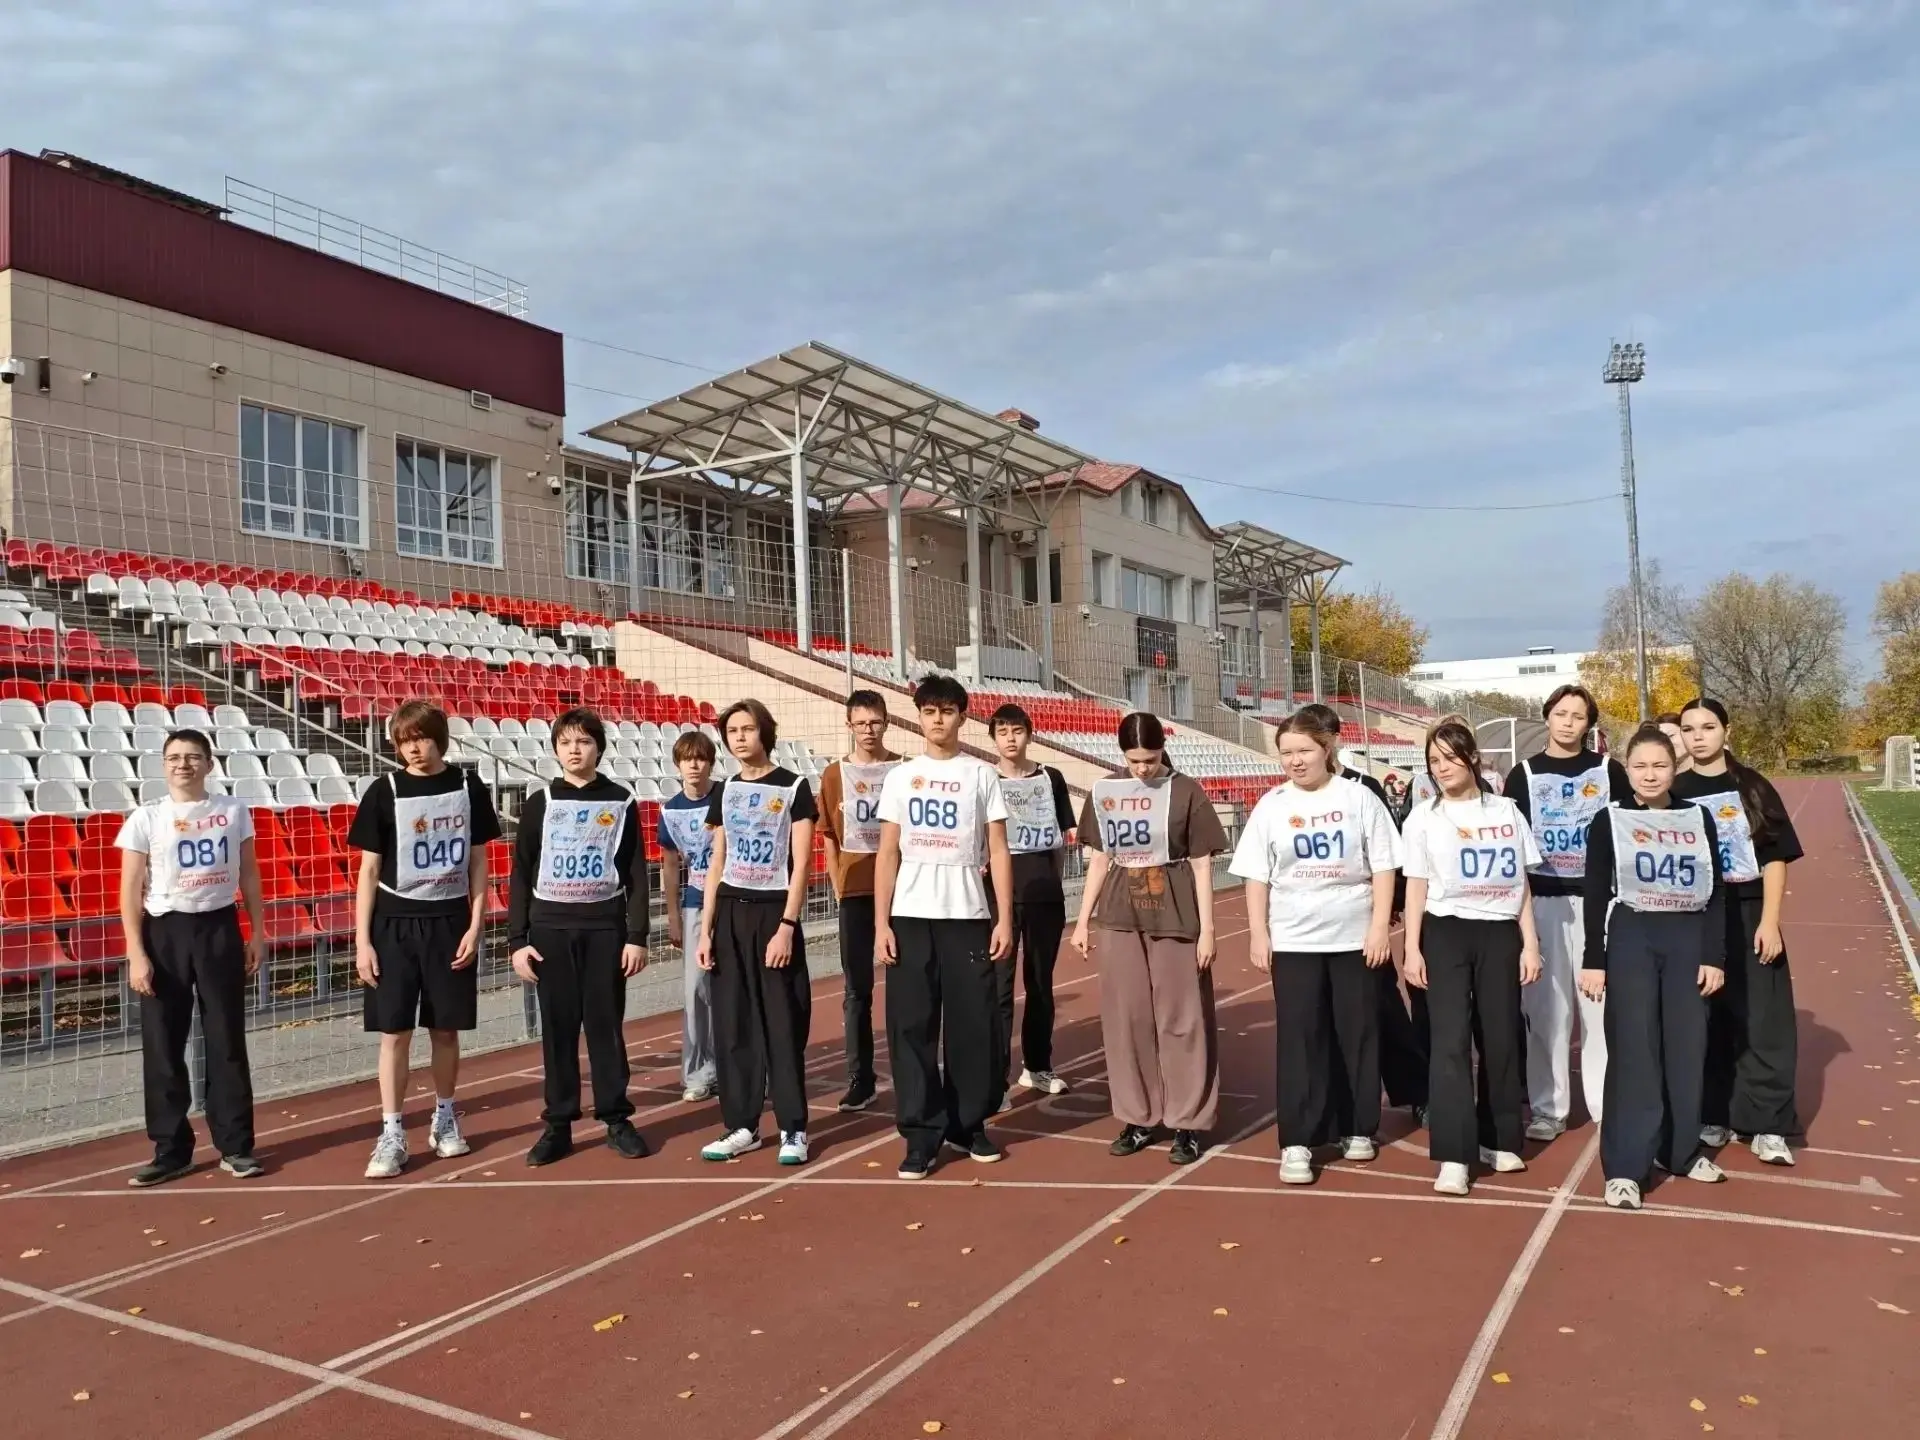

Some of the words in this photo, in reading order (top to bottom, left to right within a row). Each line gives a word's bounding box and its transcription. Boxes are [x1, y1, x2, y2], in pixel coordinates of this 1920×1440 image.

[870, 783, 884, 793] ГТ
[929, 779, 961, 793] ГТО
[1002, 790, 1021, 798] РОСС
[856, 799, 880, 823] 04
[908, 797, 958, 829] 068
[1119, 797, 1152, 811] ГТО
[433, 814, 465, 831] ГТО
[1311, 810, 1343, 828] ГТО
[1106, 819, 1151, 848] 028
[1478, 823, 1514, 841] ГТО
[1656, 829, 1697, 845] ГТО
[177, 835, 229, 868] 081
[413, 837, 466, 870] 040
[736, 837, 774, 864] 9932
[1293, 828, 1345, 860] 061
[552, 854, 603, 879] 9936
[1460, 846, 1517, 879] 073
[1635, 851, 1696, 887] 045
[1292, 870, 1348, 879] «СПАРТАК»
[1636, 895, 1697, 909] «СПАРТАК»
